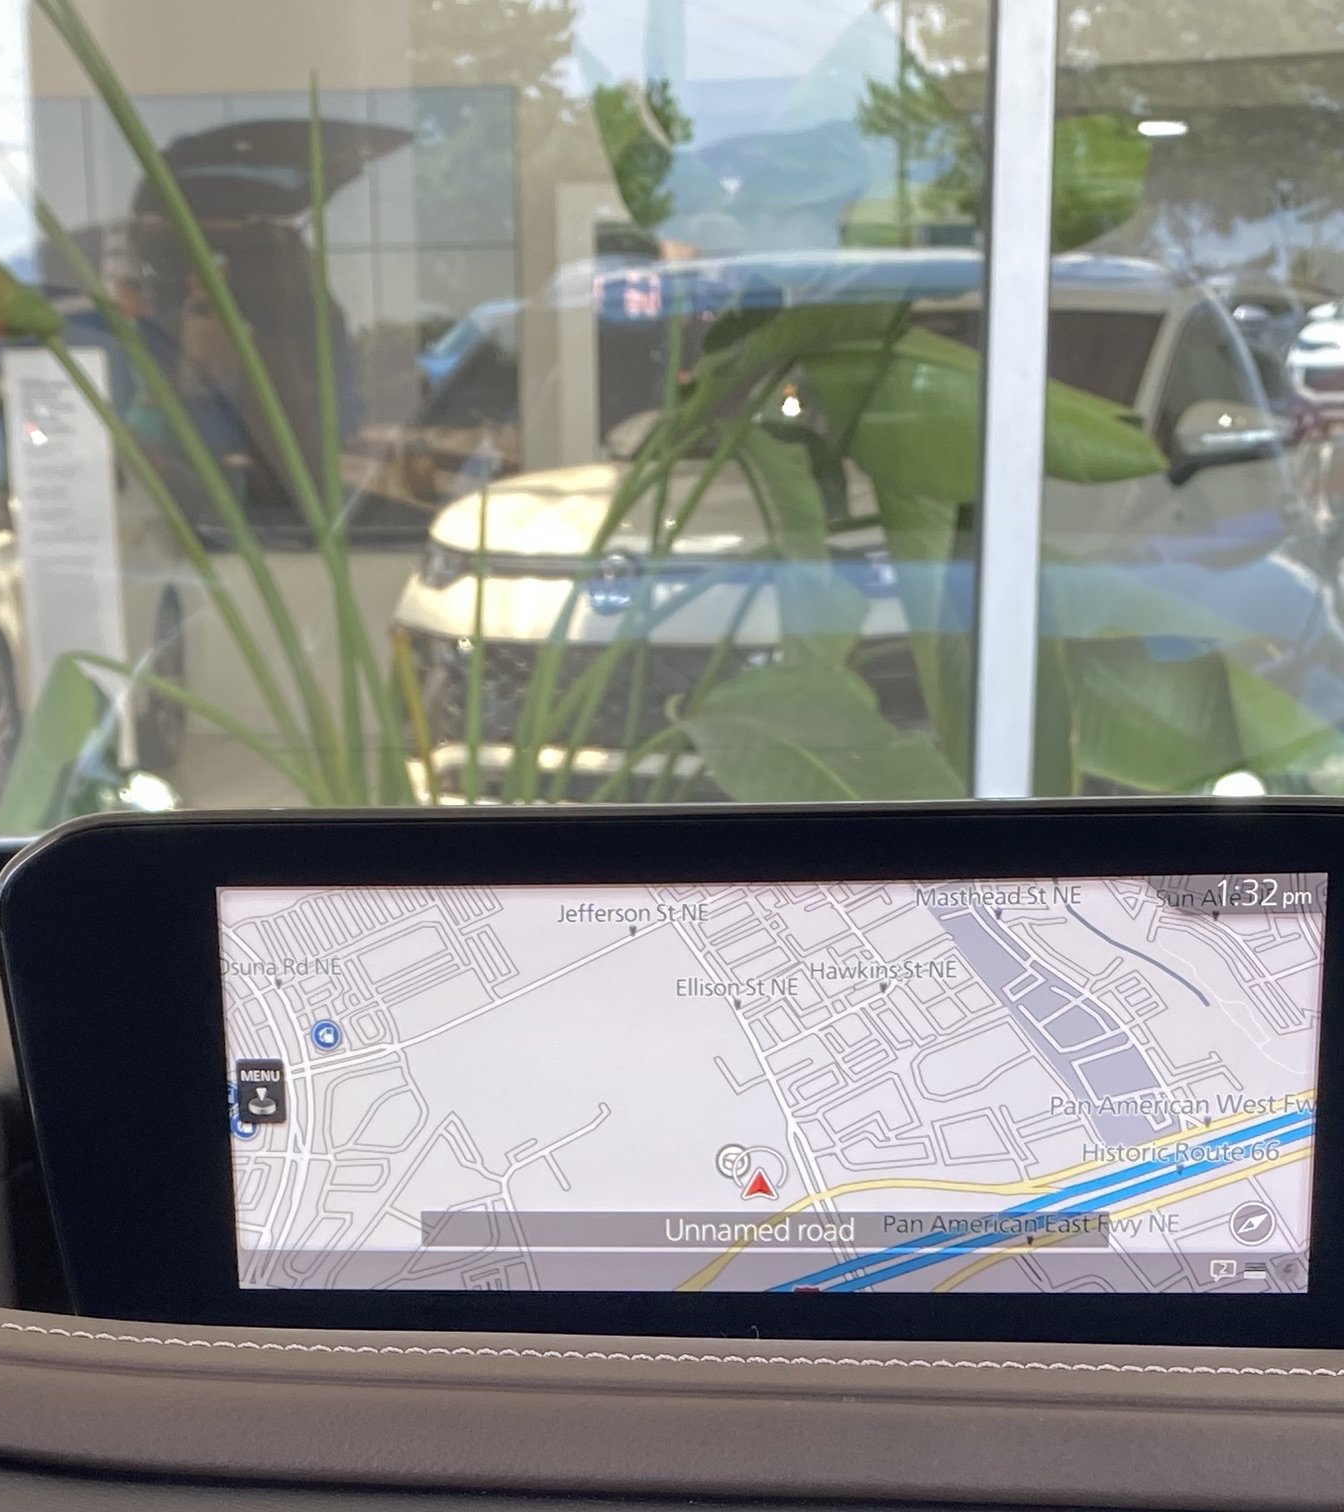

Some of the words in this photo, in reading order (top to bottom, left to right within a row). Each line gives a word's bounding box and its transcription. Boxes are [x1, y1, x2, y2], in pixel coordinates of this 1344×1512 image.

[915, 887, 1021, 906] Masthead
[1028, 887, 1049, 905] St
[1053, 886, 1081, 904] NE
[1157, 890, 1194, 907] Sun
[1217, 879, 1278, 907] 1:32
[1282, 891, 1312, 908] pm
[557, 903, 650, 923] Jefferson
[656, 904, 674, 922] St
[677, 904, 709, 921] NE
[284, 958, 308, 976] Rd
[315, 958, 342, 976] NE
[810, 961, 897, 980] Hawkins
[903, 961, 926, 979] St
[929, 960, 956, 978] NE
[676, 978, 740, 998] Ellison
[743, 978, 764, 996] St
[768, 978, 798, 996] NE
[240, 1069, 281, 1082] MENU
[1051, 1096, 1092, 1115] Pan
[1098, 1096, 1209, 1115] American
[1217, 1094, 1276, 1114] West
[1082, 1143, 1168, 1162] Historic
[1175, 1142, 1244, 1161] Route
[1251, 1141, 1280, 1161] 66
[666, 1218, 790, 1241] Unnamed
[798, 1218, 855, 1241] road
[883, 1216, 923, 1234] Pan
[930, 1215, 1036, 1234] American
[1046, 1215, 1090, 1233] East
[1098, 1215, 1142, 1237] Fwy
[1150, 1214, 1179, 1232] NE
